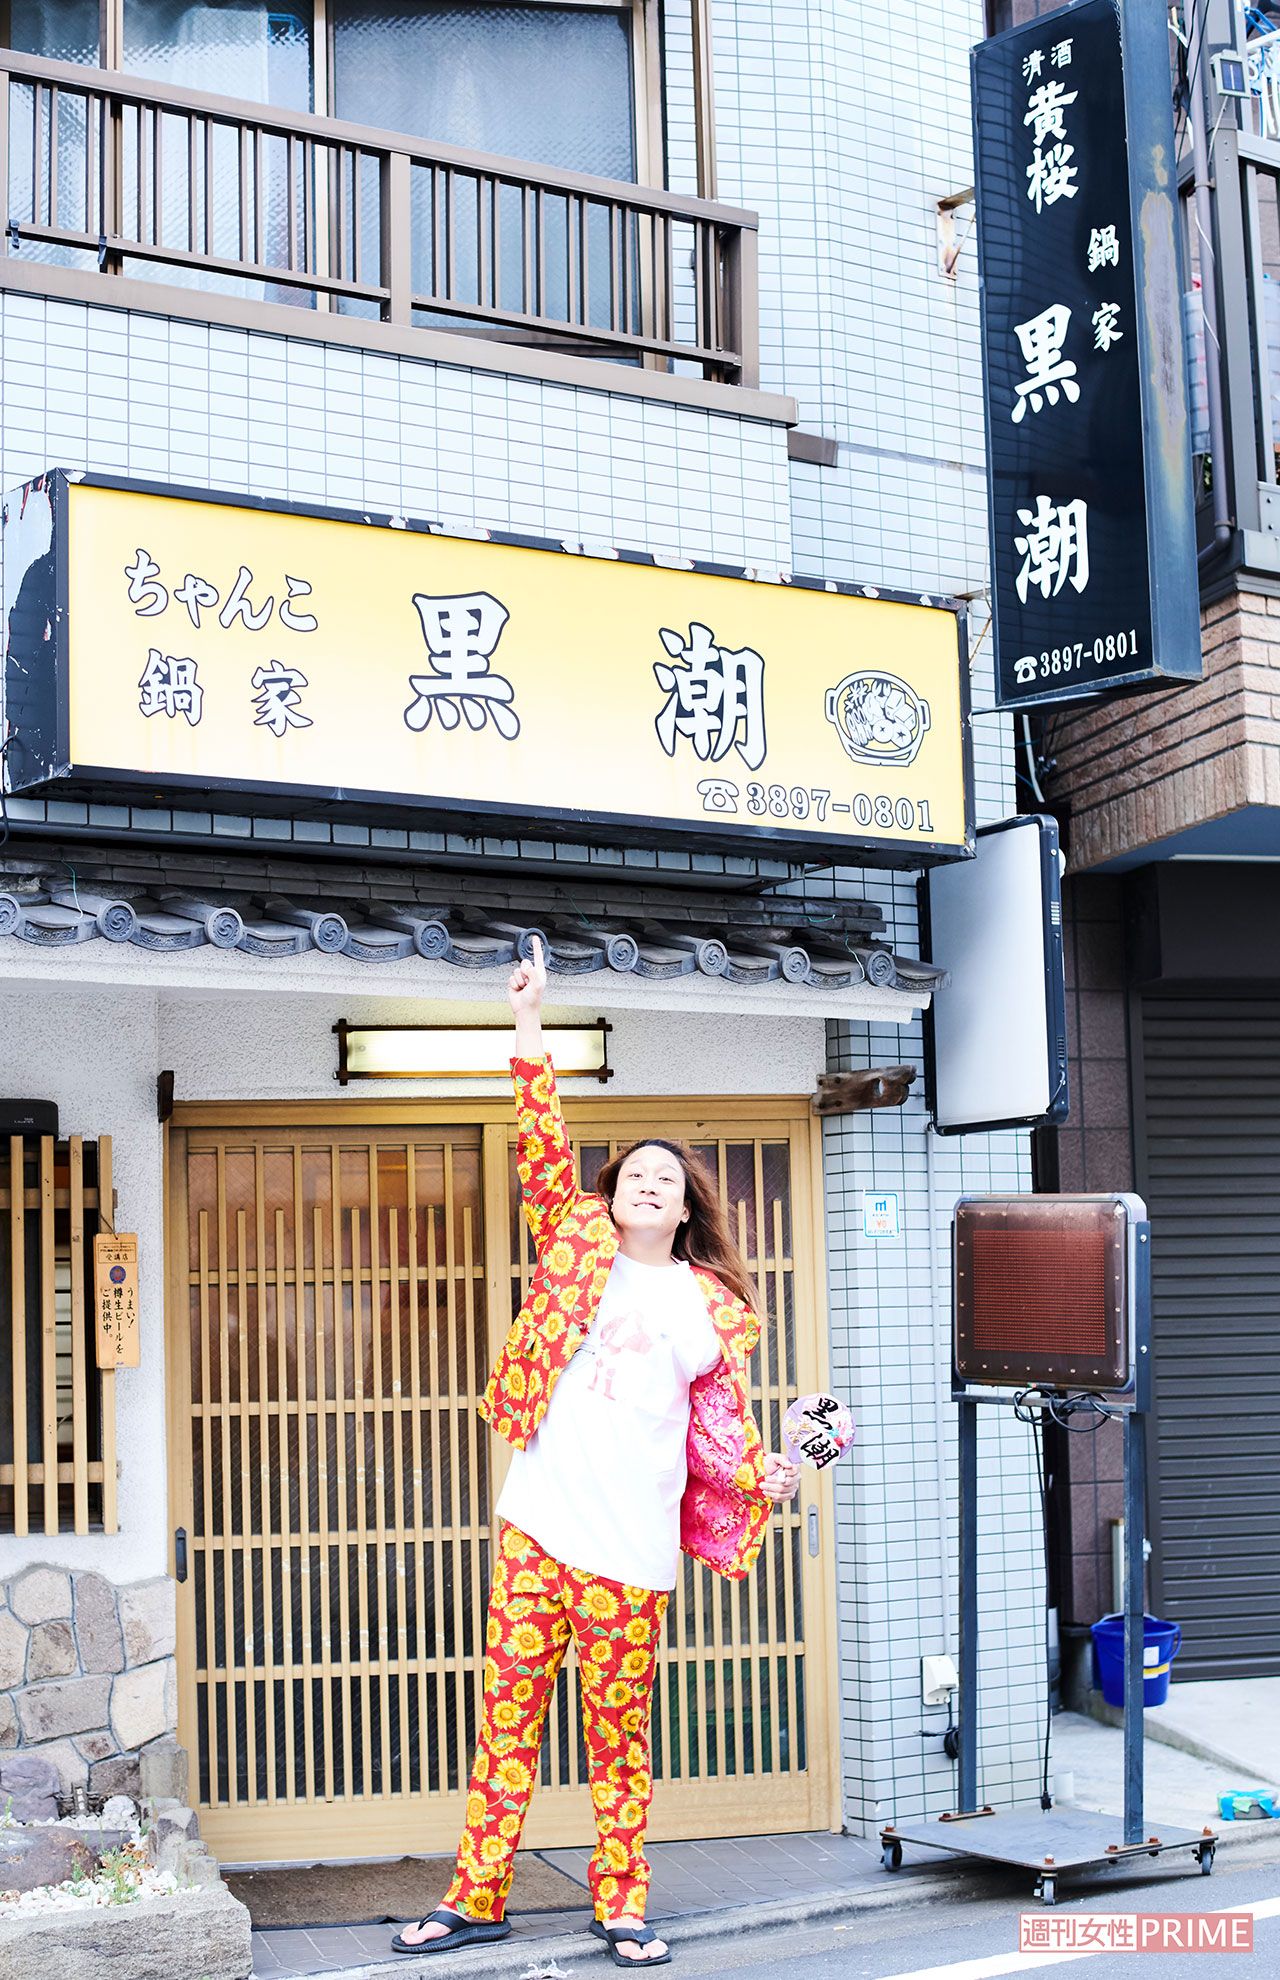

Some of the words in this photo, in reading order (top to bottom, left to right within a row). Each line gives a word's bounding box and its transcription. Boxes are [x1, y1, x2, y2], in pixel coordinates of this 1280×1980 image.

[1022, 38, 1074, 86] 清酒
[1023, 80, 1079, 214] 黄桜
[1011, 303, 1089, 605] 黒潮
[124, 548, 318, 632] ちゃんこ
[1039, 629, 1139, 678] 3897-0801
[746, 782, 934, 832] 3897-0801
